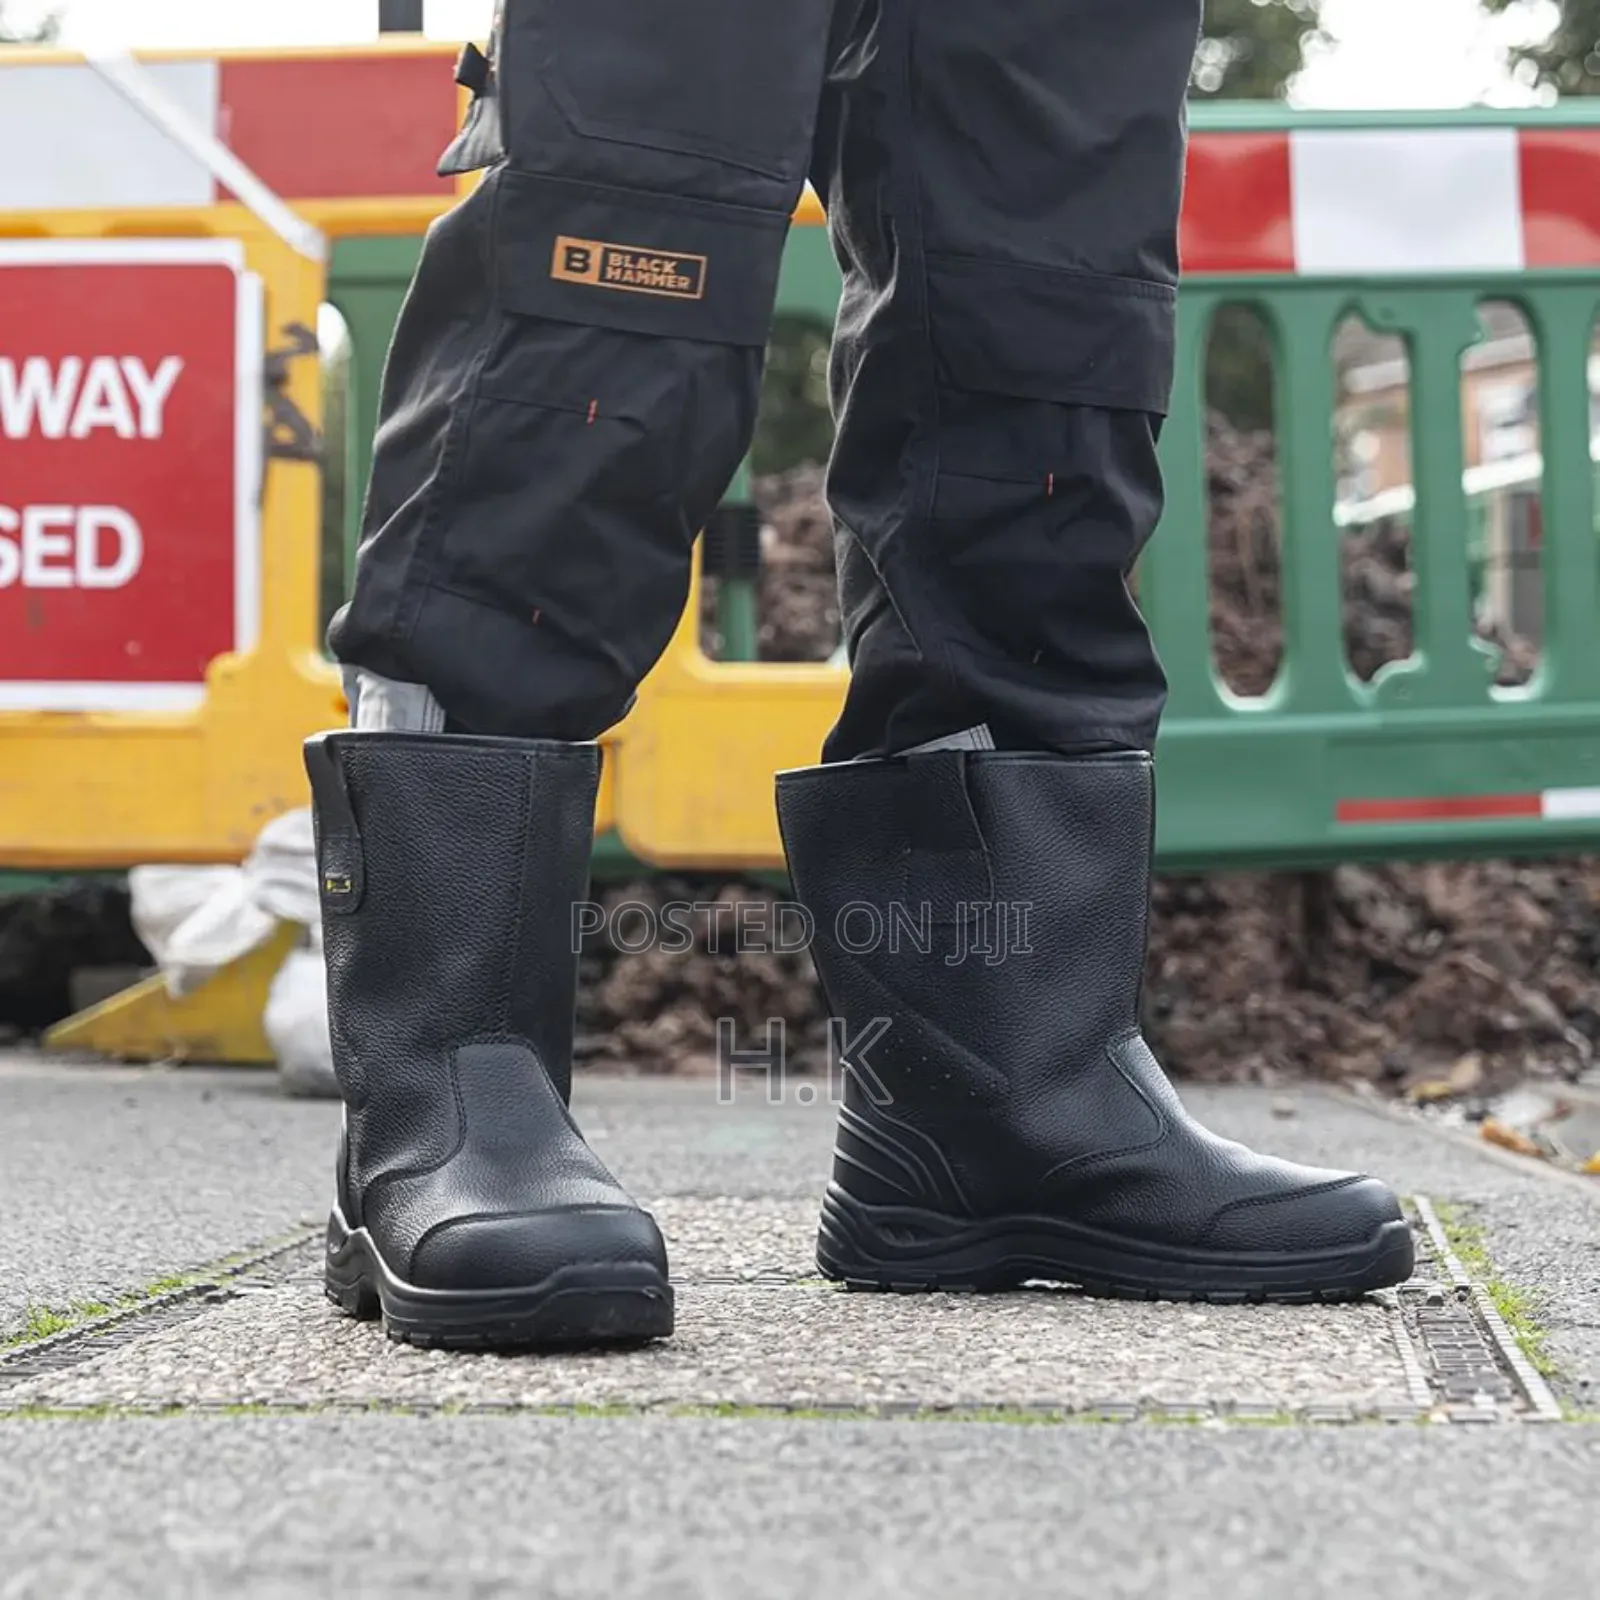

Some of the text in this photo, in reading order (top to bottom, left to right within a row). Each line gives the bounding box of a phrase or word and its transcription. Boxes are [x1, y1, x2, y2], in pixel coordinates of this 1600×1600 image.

[564, 246, 591, 273] B
[607, 252, 678, 274] BLACK
[605, 265, 691, 289] HAMMER
